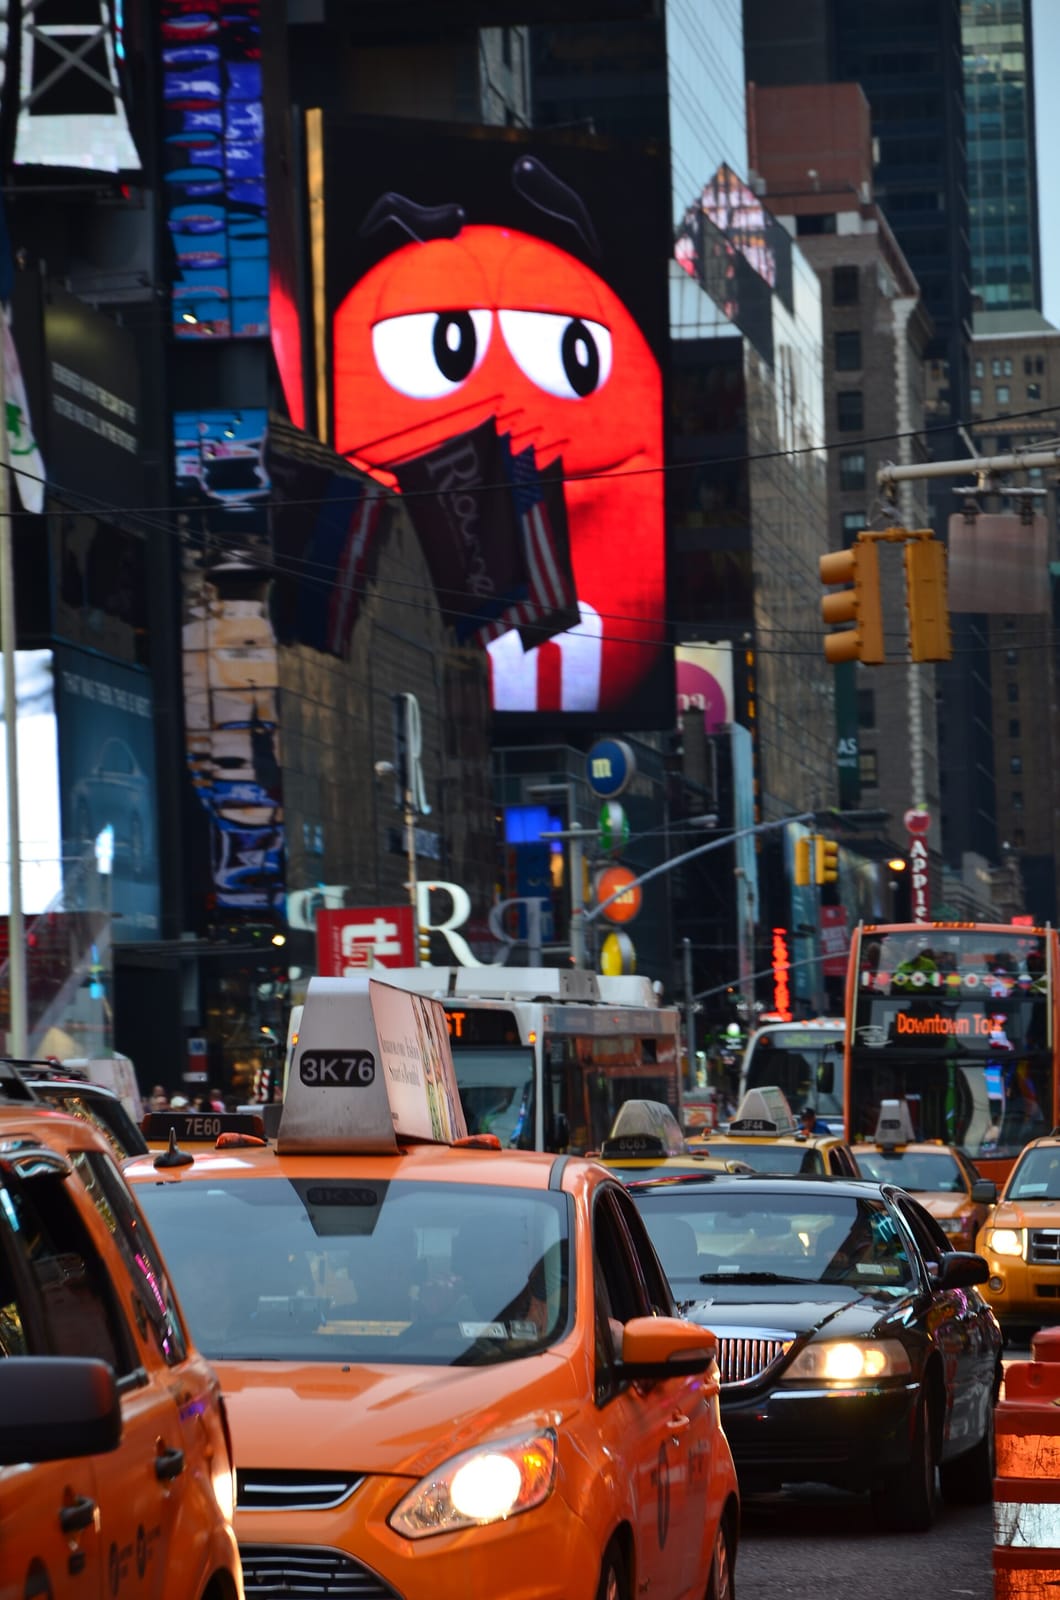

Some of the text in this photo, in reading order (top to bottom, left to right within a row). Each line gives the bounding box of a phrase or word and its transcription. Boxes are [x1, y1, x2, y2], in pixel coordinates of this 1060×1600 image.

[896, 1012, 970, 1035] Downtown
[302, 1057, 375, 1082] 3K76
[185, 1118, 221, 1136] 7E60
